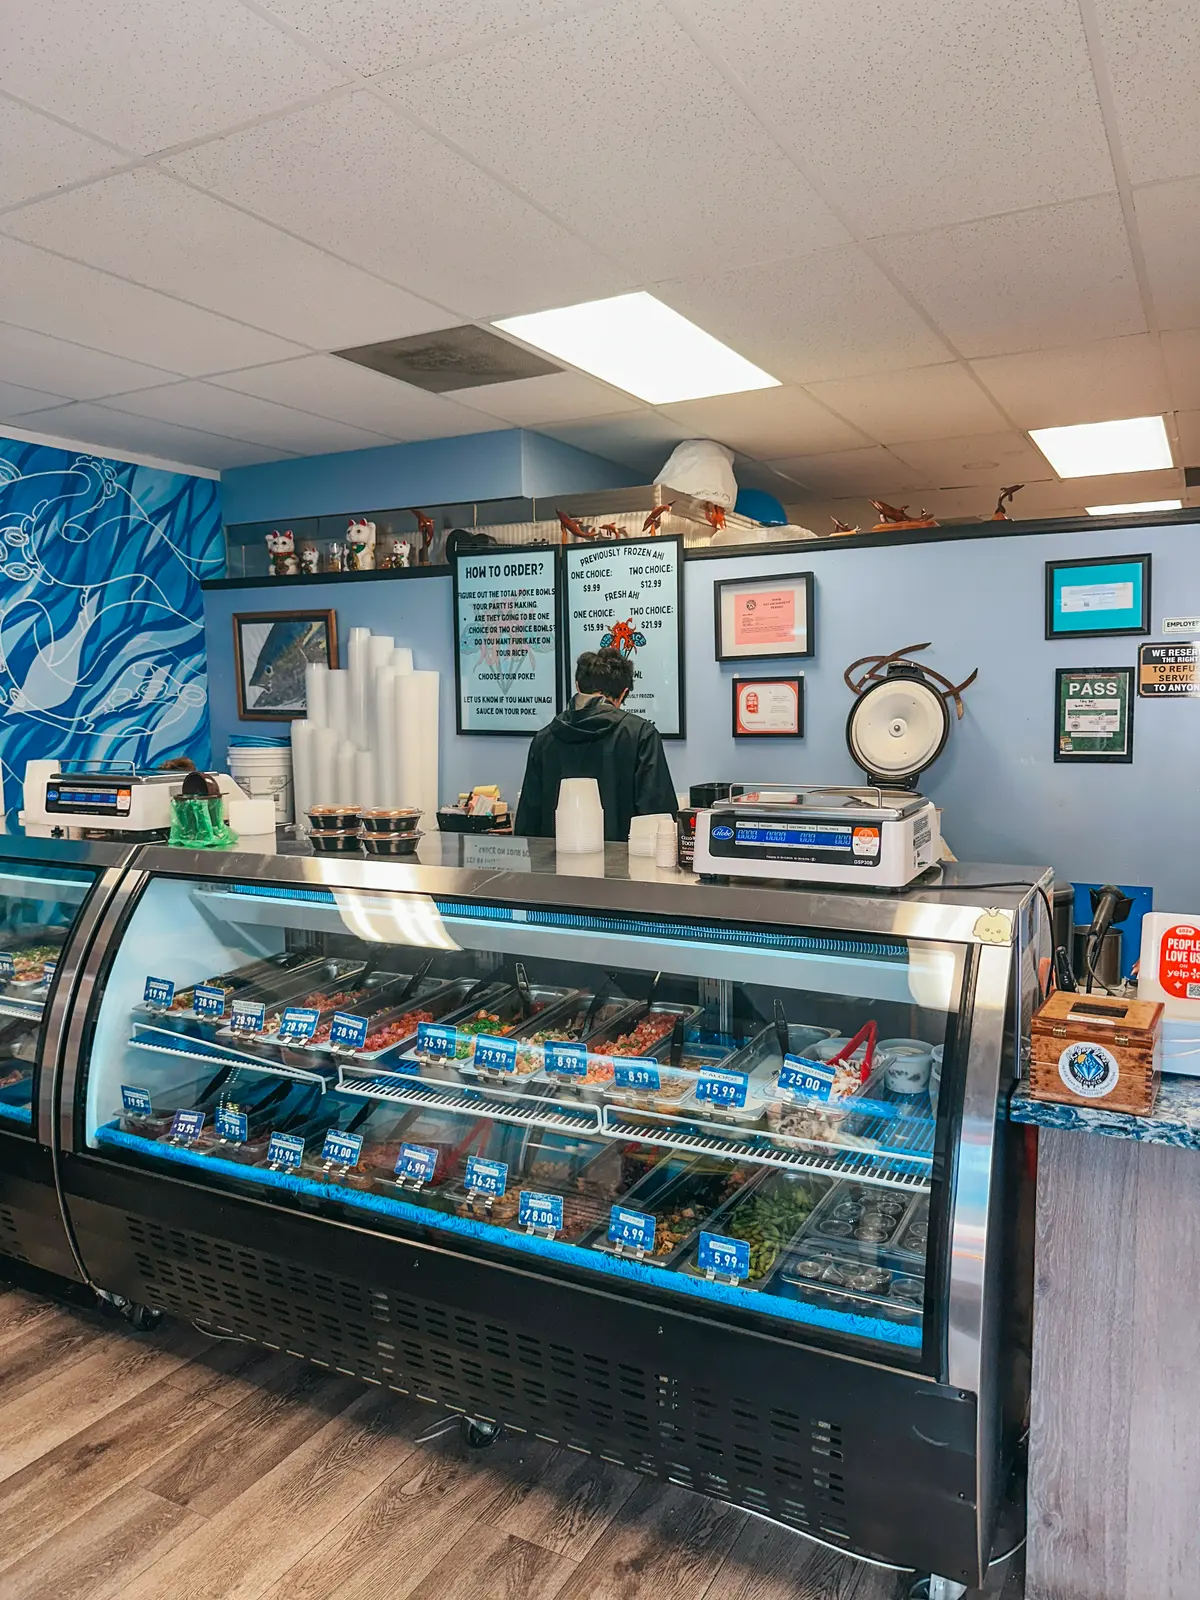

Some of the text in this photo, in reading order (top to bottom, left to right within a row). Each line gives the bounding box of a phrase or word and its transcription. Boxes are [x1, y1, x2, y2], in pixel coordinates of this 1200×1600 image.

[580, 548, 665, 566] PREVIOUSLY FROZEN AHI
[466, 563, 544, 578] HOW TO ORDER?
[571, 569, 612, 579] ONE CHOICE:
[629, 564, 673, 575] TWO CHOICE:
[583, 584, 600, 592] $9.99
[641, 580, 662, 588] $12.99
[489, 590, 499, 598] THE
[500, 590, 517, 598] TOTAL
[519, 589, 534, 597] POKE
[536, 588, 555, 596] BOWLS
[605, 590, 640, 601] FRESH AHI
[489, 602, 506, 610] PARTY
[645, 606, 673, 615] CHOICE:
[574, 609, 615, 618] ONE CHOICE:
[584, 623, 604, 632] $15.99
[641, 620, 662, 628] $21.99
[1152, 648, 1200, 657] WE RESER
[1069, 682, 1117, 695] PASS
[1168, 938, 1200, 951] PEOPLE
[1166, 950, 1200, 964] LOVE US
[1167, 969, 1189, 978] yelp
[236, 1015, 256, 1026] 28.99
[286, 1022, 308, 1032] 28.99
[337, 1026, 358, 1040] 28.99
[424, 1037, 447, 1049] 26.99
[482, 1050, 506, 1063] 29.99
[558, 1056, 577, 1069] 8.99
[629, 1071, 649, 1083] 8.99
[788, 1073, 820, 1091] 25.00
[706, 1082, 735, 1099] 15.99
[330, 1144, 351, 1158] 14.00
[407, 1160, 426, 1174] 6.99
[472, 1174, 496, 1189] 16.25
[623, 1226, 644, 1242] 6.99
[714, 1252, 737, 1268] 5.99
